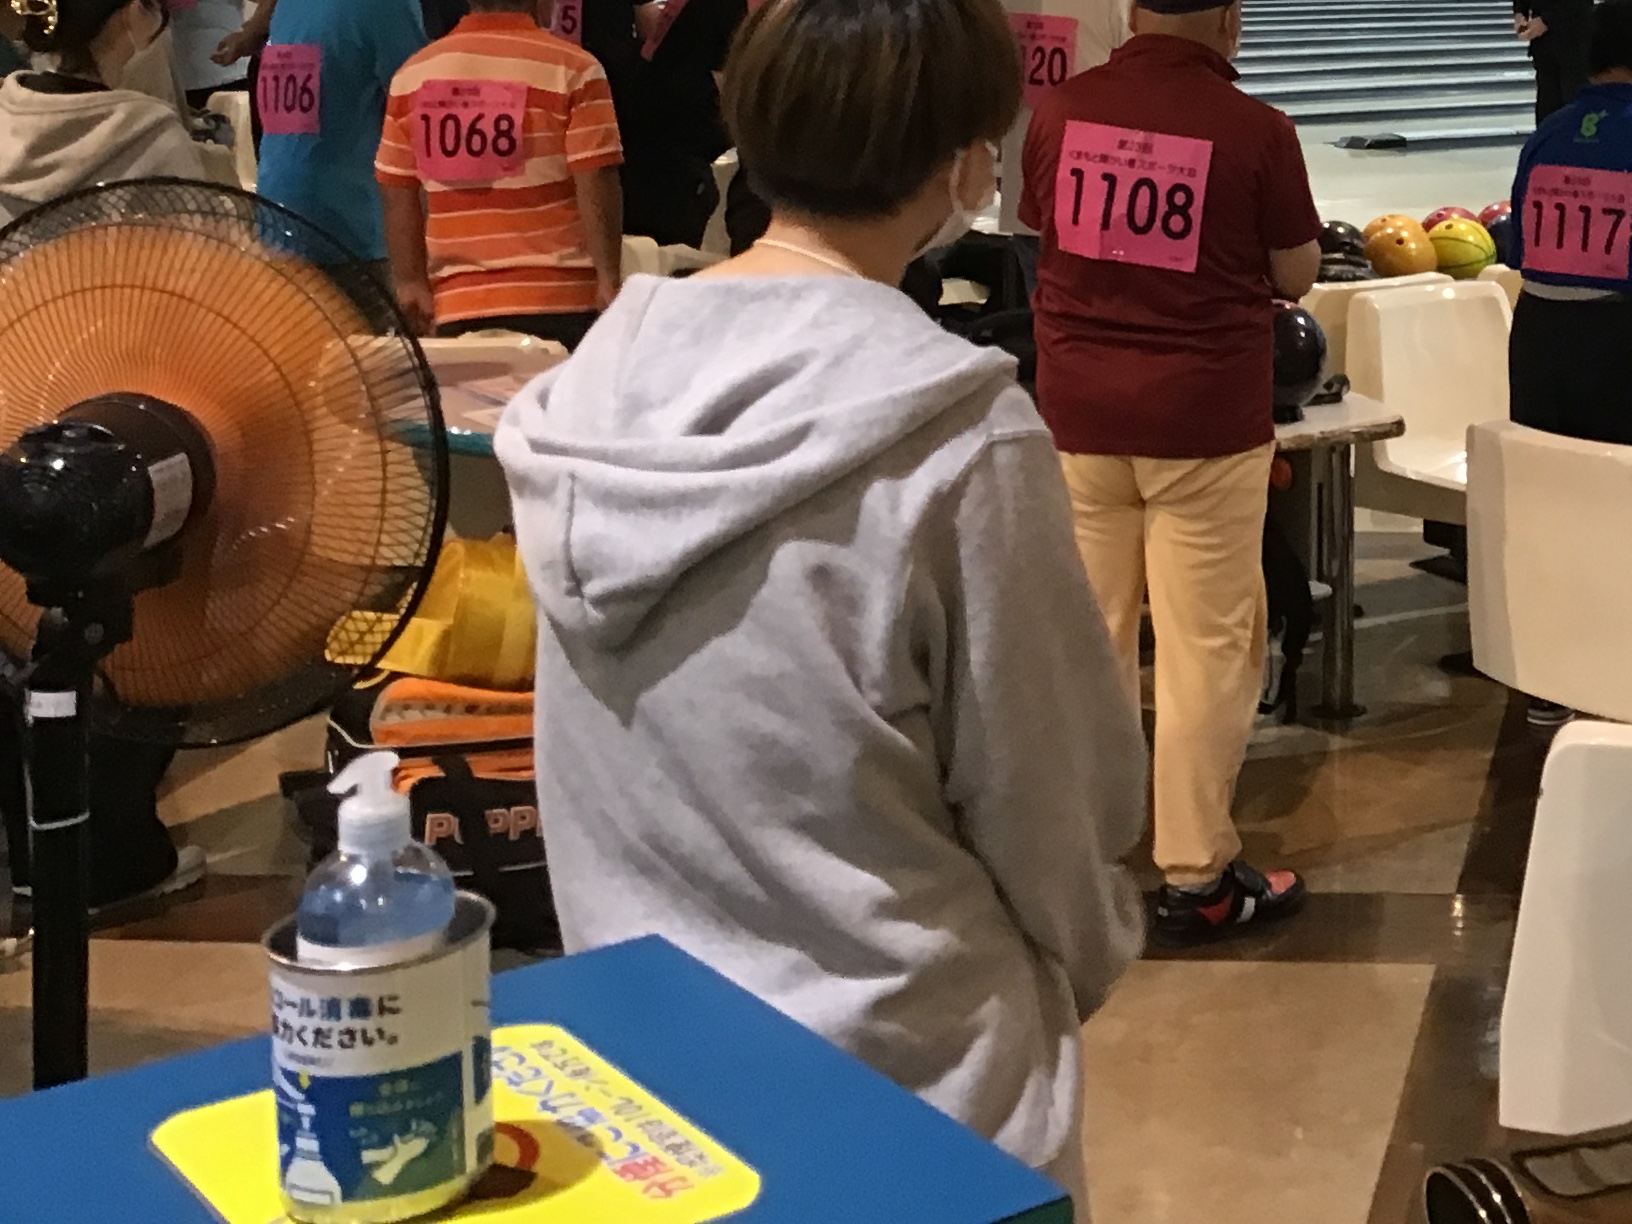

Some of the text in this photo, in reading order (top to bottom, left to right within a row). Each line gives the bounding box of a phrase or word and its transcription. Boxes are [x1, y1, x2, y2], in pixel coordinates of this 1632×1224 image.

[261, 74, 315, 114] 1106
[420, 112, 517, 158] 1068
[1069, 167, 1195, 240] 1108
[1532, 200, 1626, 255] 1117
